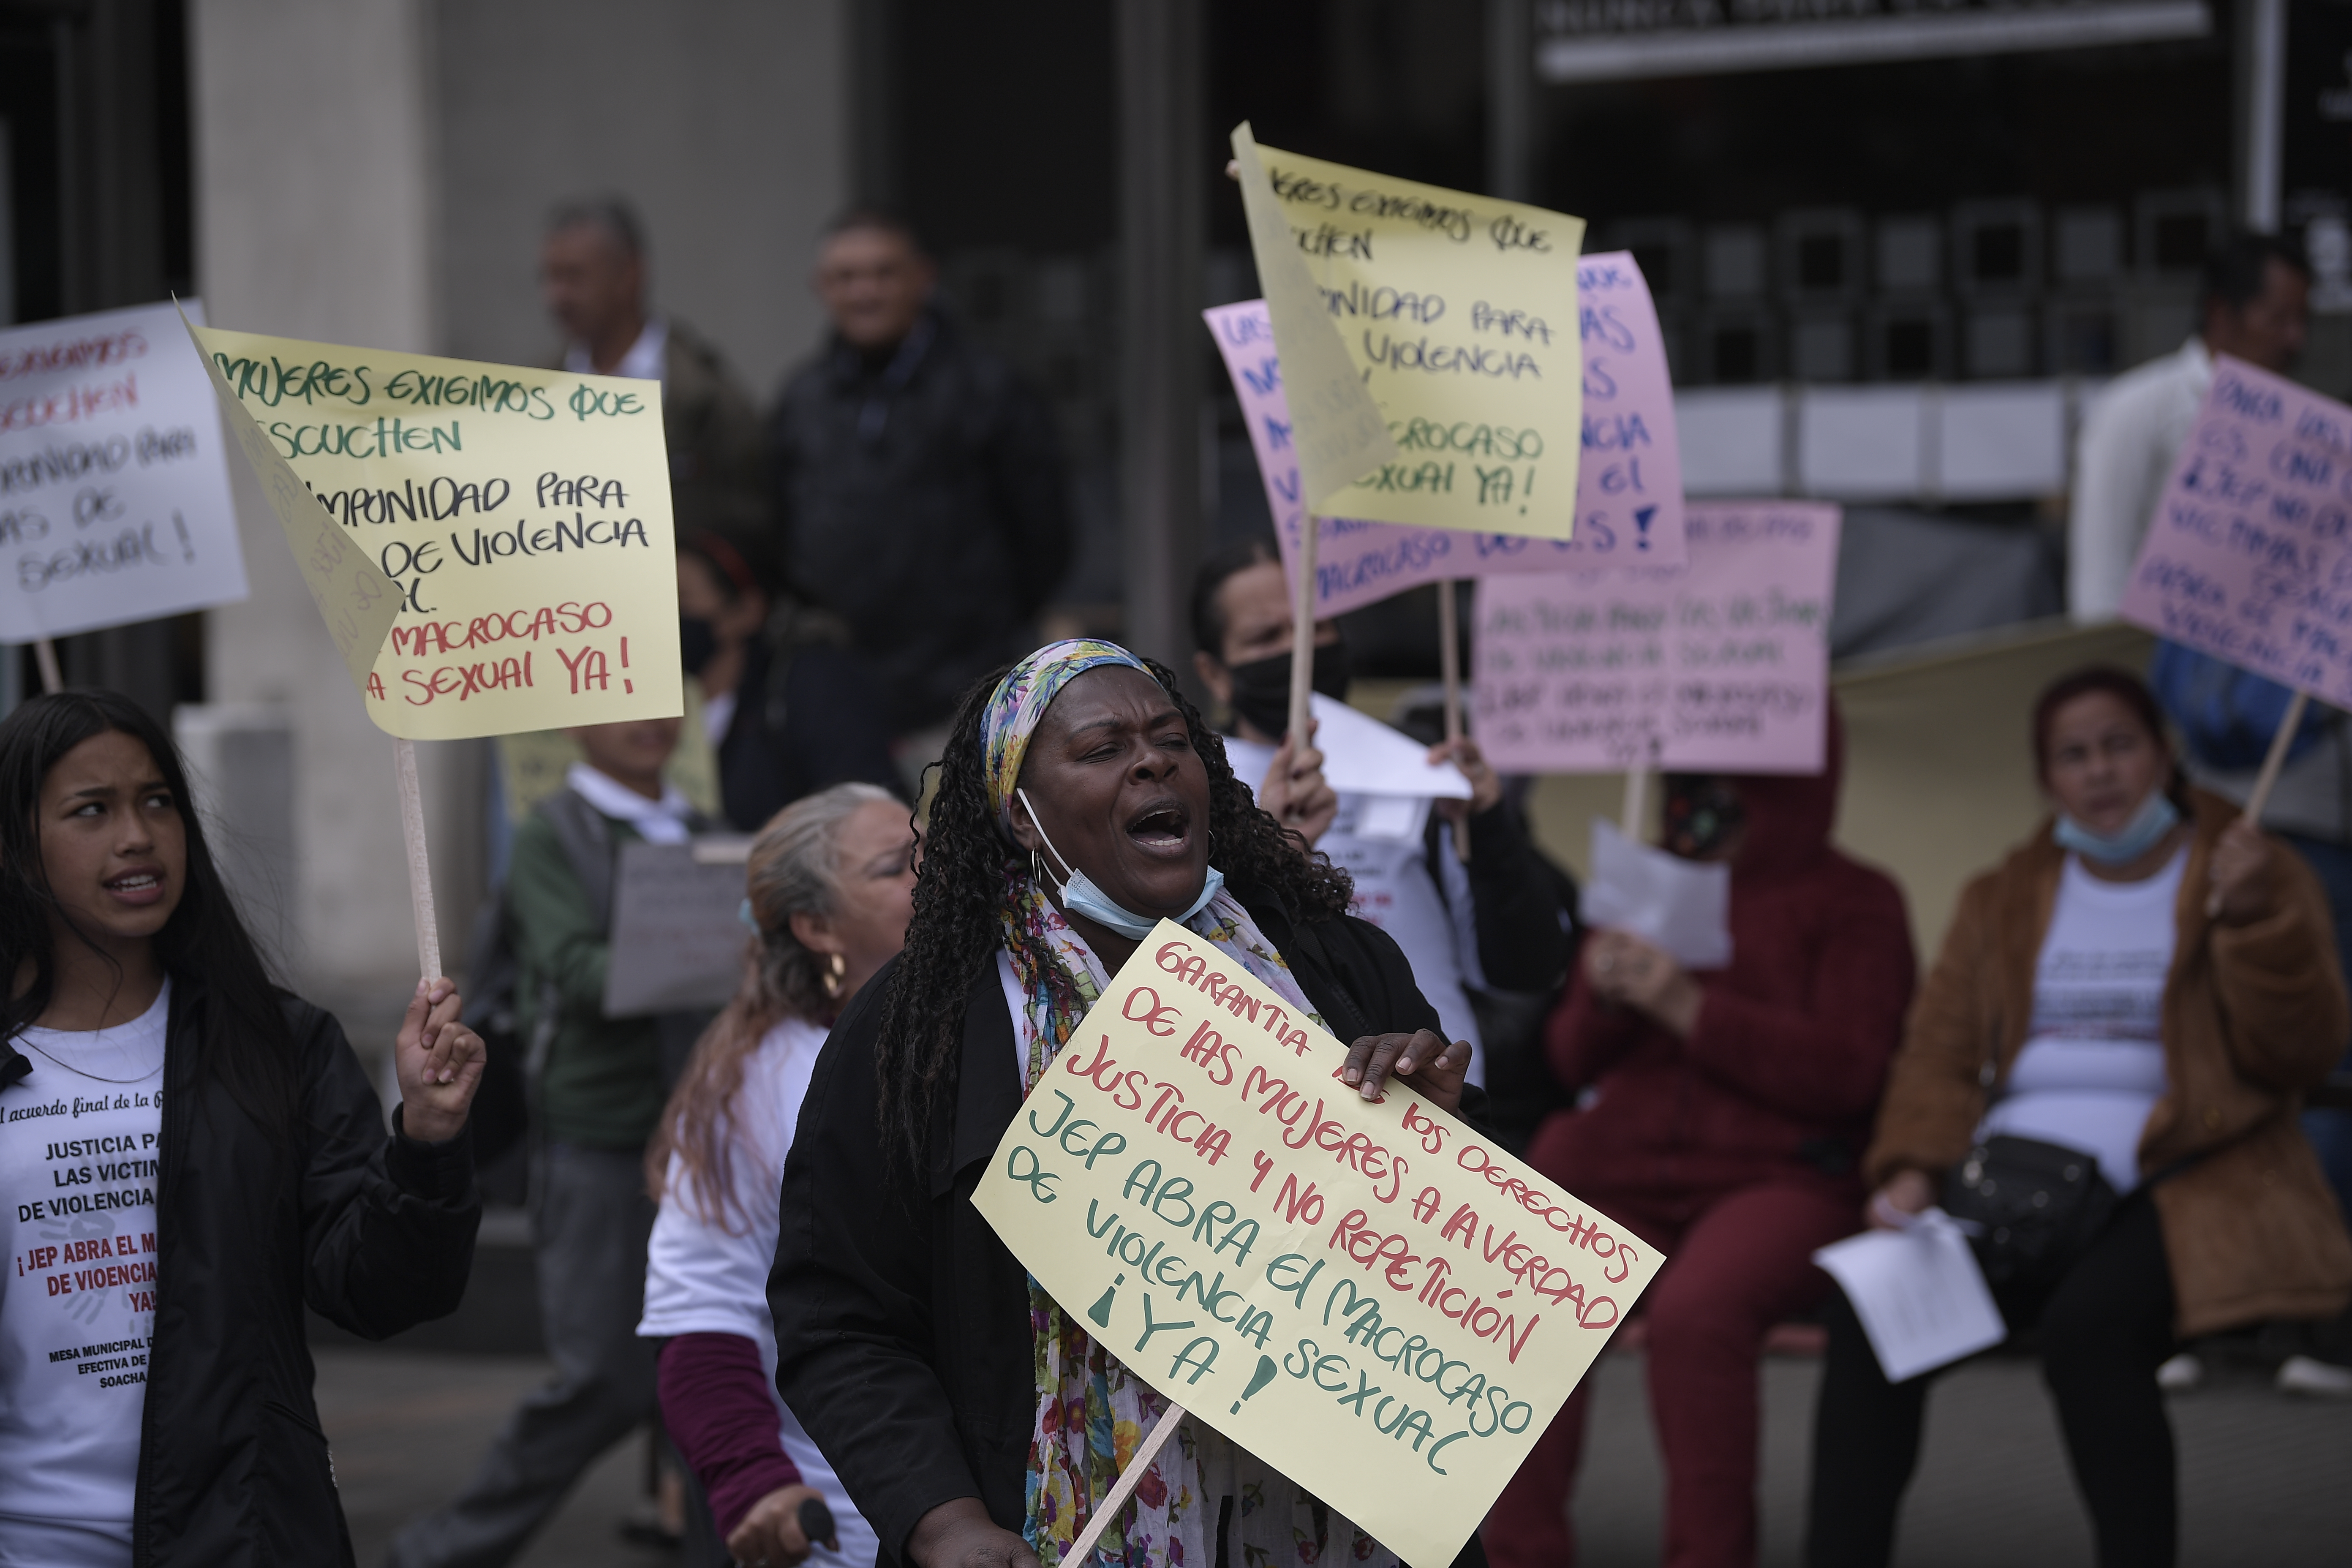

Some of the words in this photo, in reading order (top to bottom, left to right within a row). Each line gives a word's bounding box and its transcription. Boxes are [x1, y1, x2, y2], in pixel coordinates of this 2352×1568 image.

[1489, 214, 1555, 253] QUE
[1471, 298, 1557, 348] PARA
[1362, 328, 1544, 382] VIOLENCIA
[213, 352, 373, 407] MUJERES
[384, 369, 555, 420] EXIGIMOS
[569, 383, 645, 422] QUE
[73, 485, 127, 530] DE
[536, 471, 631, 509] PARA
[1473, 465, 1538, 516] YA!
[381, 541, 443, 578] DE
[451, 512, 649, 566] VIOLENCIA
[391, 601, 613, 657] MACROCASO
[8, 1099, 67, 1122] acuerdo
[72, 1094, 109, 1119] final
[114, 1094, 130, 1110] de
[134, 1093, 150, 1107] la
[1154, 940, 1312, 1058] GARANTIA
[1456, 1144, 1639, 1284] DERECHOS
[46, 1135, 137, 1160] JUSTICIA
[1121, 985, 1183, 1037] DE
[1240, 1064, 1410, 1204] MUJERES
[1411, 1186, 1441, 1225] A
[1483, 1223, 1619, 1330] VERDAD
[54, 1167, 92, 1187] LAS
[1065, 1033, 1232, 1167] JUSTICIA
[1249, 1149, 1275, 1193] Y
[1272, 1172, 1326, 1226] NO
[1328, 1208, 1541, 1365] REPETICIÓN
[18, 1202, 45, 1222] DE
[49, 1188, 155, 1217] VIOLENCIA
[64, 1238, 113, 1264] ABRA
[116, 1235, 138, 1256] EL
[1028, 1088, 1127, 1171] JEP
[1122, 1158, 1261, 1268] ABRA
[1322, 1278, 1533, 1438] MACROCASO
[46, 1273, 72, 1297] DE
[75, 1261, 157, 1293] VIOENCIA
[1007, 1145, 1063, 1205] DE
[1086, 1197, 1274, 1351] VIOLENCIA
[1282, 1338, 1470, 1476] SEXUAL
[49, 1348, 81, 1363] MESA
[82, 1338, 144, 1358] MUNICIPAL
[78, 1357, 129, 1375] EFECTIVA
[131, 1354, 147, 1367] DE
[100, 1371, 147, 1389] SOACHA
